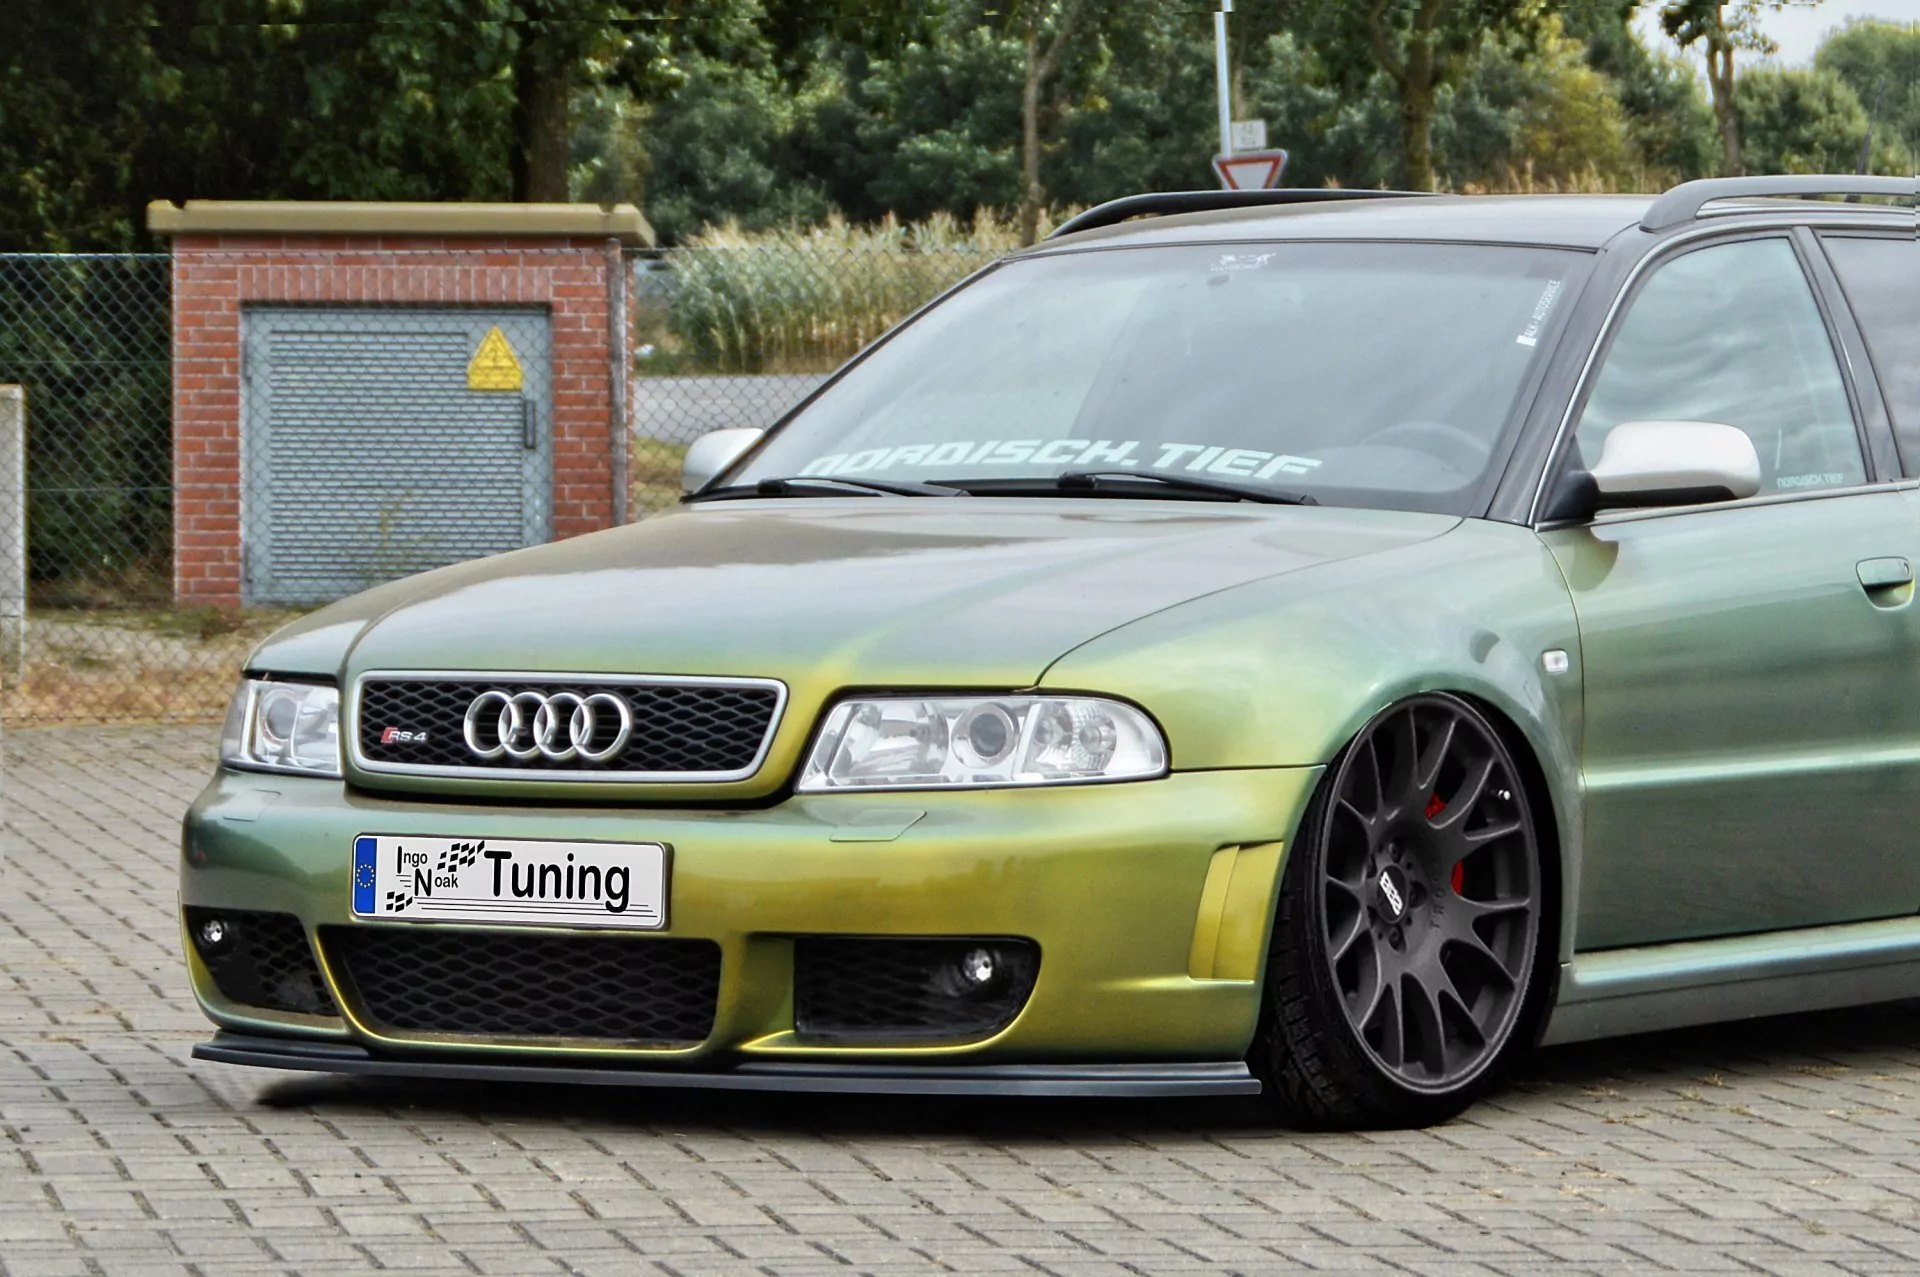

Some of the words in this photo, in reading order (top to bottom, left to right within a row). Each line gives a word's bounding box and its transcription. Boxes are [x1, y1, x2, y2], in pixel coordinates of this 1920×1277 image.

[1152, 442, 1323, 479] TIEF
[397, 845, 428, 875] Ingo
[414, 868, 459, 897] Noak
[483, 850, 631, 914] Tuning
